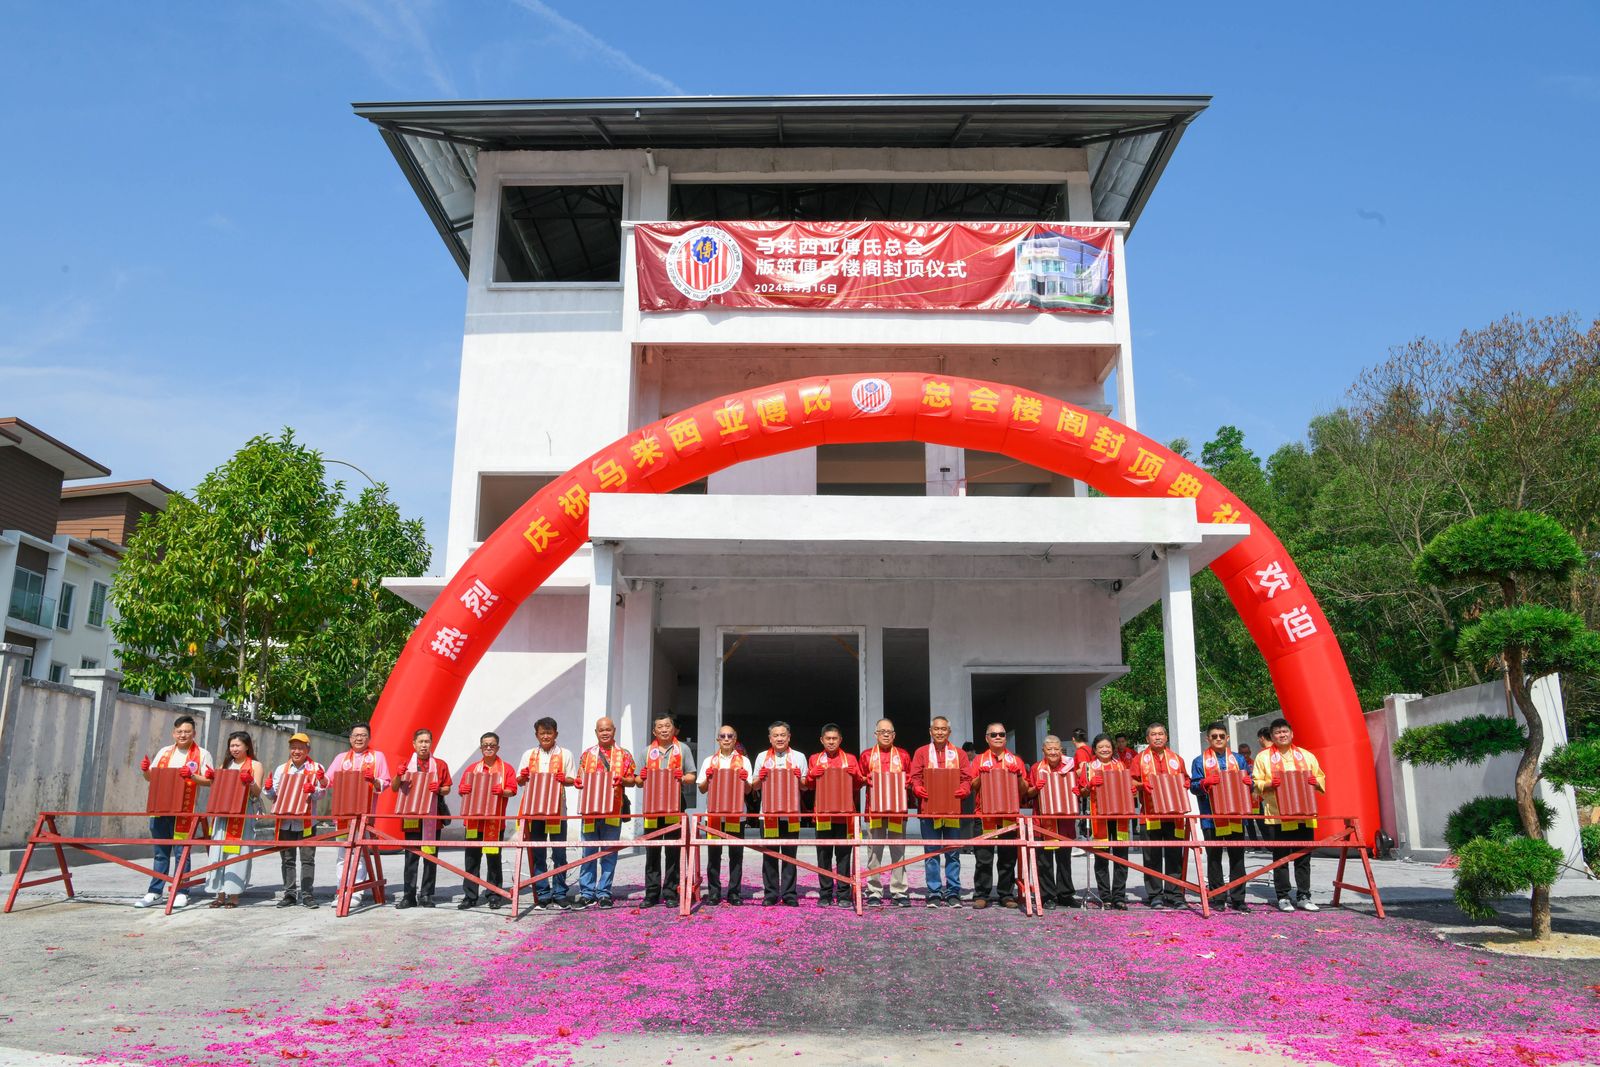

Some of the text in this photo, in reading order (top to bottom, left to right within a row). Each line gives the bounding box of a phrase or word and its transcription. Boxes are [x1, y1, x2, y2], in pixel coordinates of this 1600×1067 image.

[756, 237, 924, 256] 马来西亚傅氏总会
